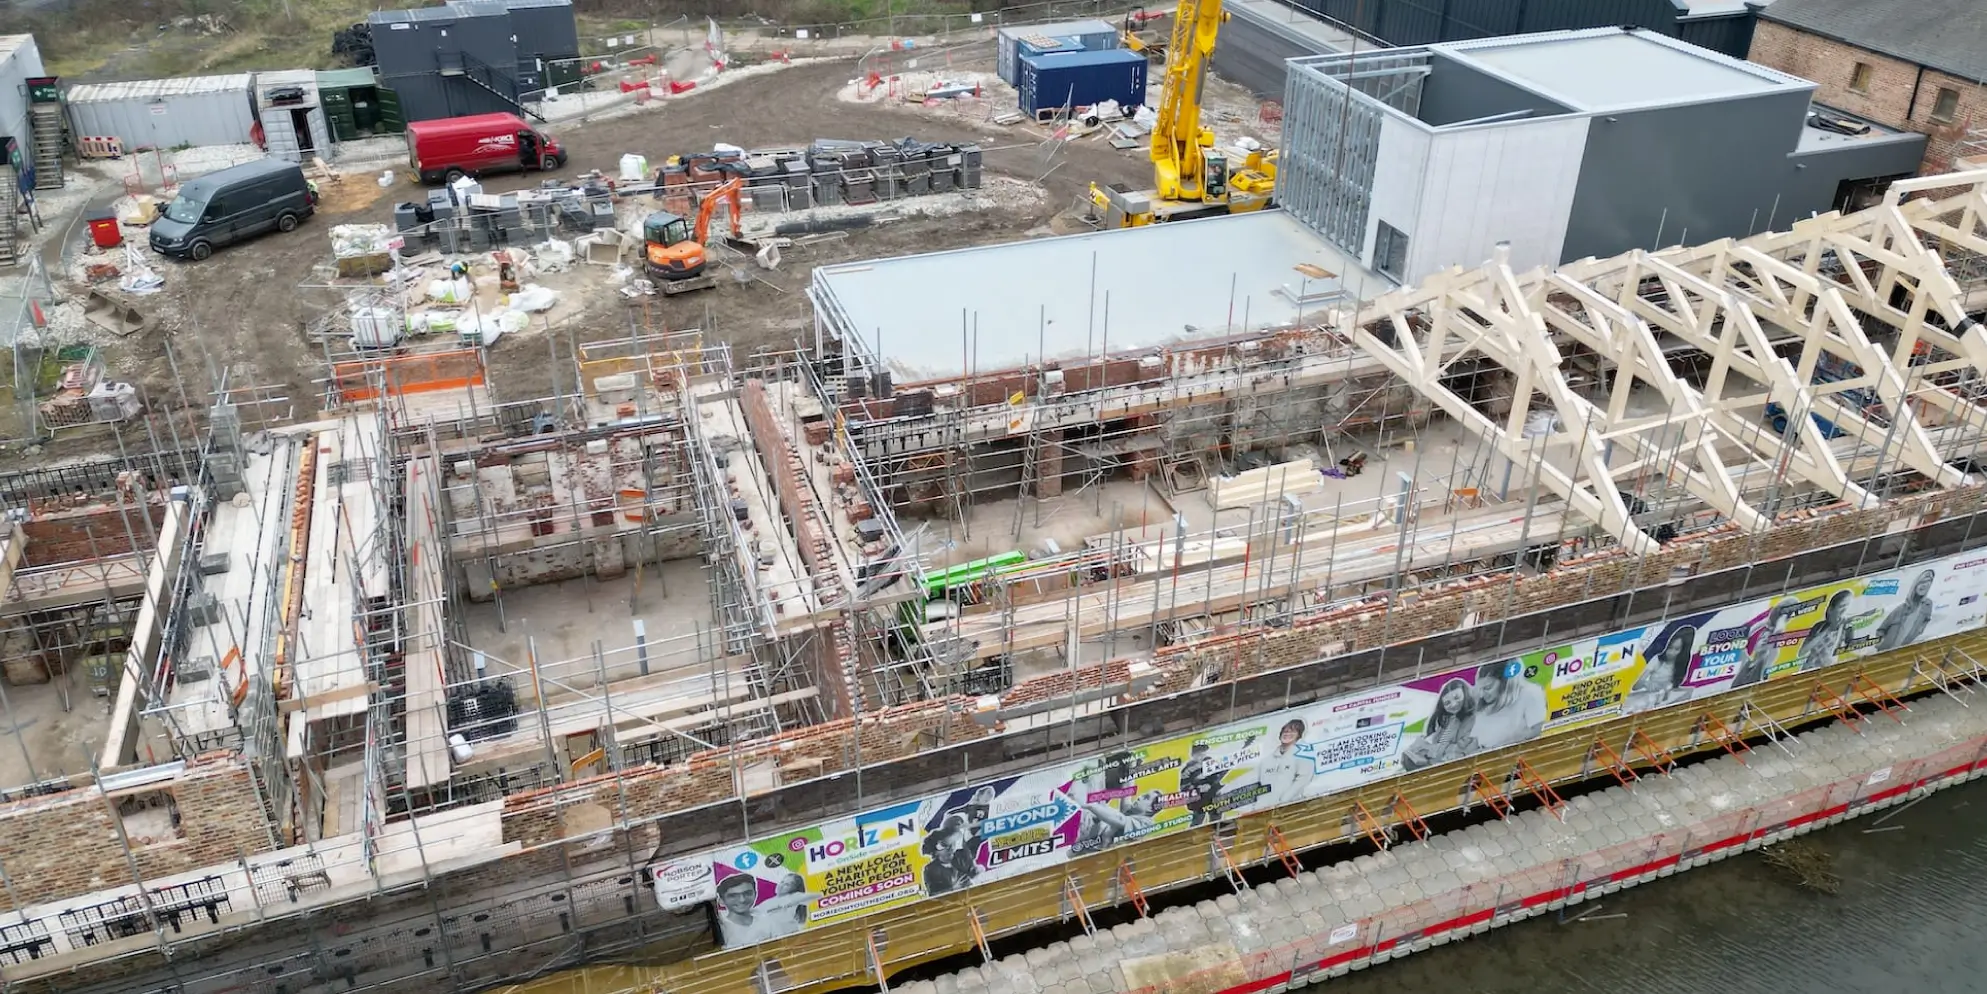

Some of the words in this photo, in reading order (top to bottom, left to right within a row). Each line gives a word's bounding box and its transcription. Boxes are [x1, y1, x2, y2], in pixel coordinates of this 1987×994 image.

[1710, 627, 1746, 643] LOOK
[1786, 638, 1798, 646] GO
[1700, 639, 1748, 656] BEYOND
[1557, 644, 1634, 677] HORIZON
[1704, 652, 1736, 666] YOUR
[1697, 665, 1735, 679] LIMITS
[1561, 690, 1589, 702] MORE
[1590, 680, 1621, 693] ABOUT
[1573, 680, 1593, 691] FIND
[1595, 674, 1615, 684] OUT
[1567, 694, 1591, 706] YOUR
[1592, 689, 1612, 699] NEW
[1194, 734, 1232, 746] SENSORY
[1235, 728, 1263, 740] ROOM
[1317, 743, 1354, 757] FORWARD
[1357, 739, 1367, 747] TO
[1369, 733, 1397, 744] TRYING
[1351, 731, 1388, 743] LOOKING
[1122, 751, 1147, 765] WALL
[1323, 752, 1340, 760] NEW
[1342, 745, 1370, 755] THINGS
[1372, 740, 1389, 748] AND
[1215, 760, 1234, 771] KICK
[1237, 751, 1260, 763] PITCH
[1321, 755, 1352, 767] MAKING
[1119, 767, 1156, 784] MARTIAL
[1158, 760, 1179, 771] ARTS
[996, 794, 1042, 814] LOK
[1157, 792, 1190, 804] HEALTH
[1202, 798, 1231, 813] YOUTH
[1232, 786, 1268, 802] WORKER
[984, 804, 1059, 834] BEYOND
[1113, 823, 1161, 844] RECORDING
[1162, 814, 1194, 829] STUDIO
[810, 818, 914, 862] HORIZON
[993, 840, 1050, 864] LIMITS
[663, 863, 702, 877] HOBSON
[825, 871, 833, 880] A
[837, 862, 864, 876] NEW
[867, 850, 908, 868] LOCAL
[826, 866, 879, 887] CHARITY
[882, 858, 906, 872] FOR
[820, 886, 874, 907] COMING
[876, 874, 914, 892] SOON
[821, 878, 865, 897] YOUNG
[868, 864, 913, 885] PEOPLE
